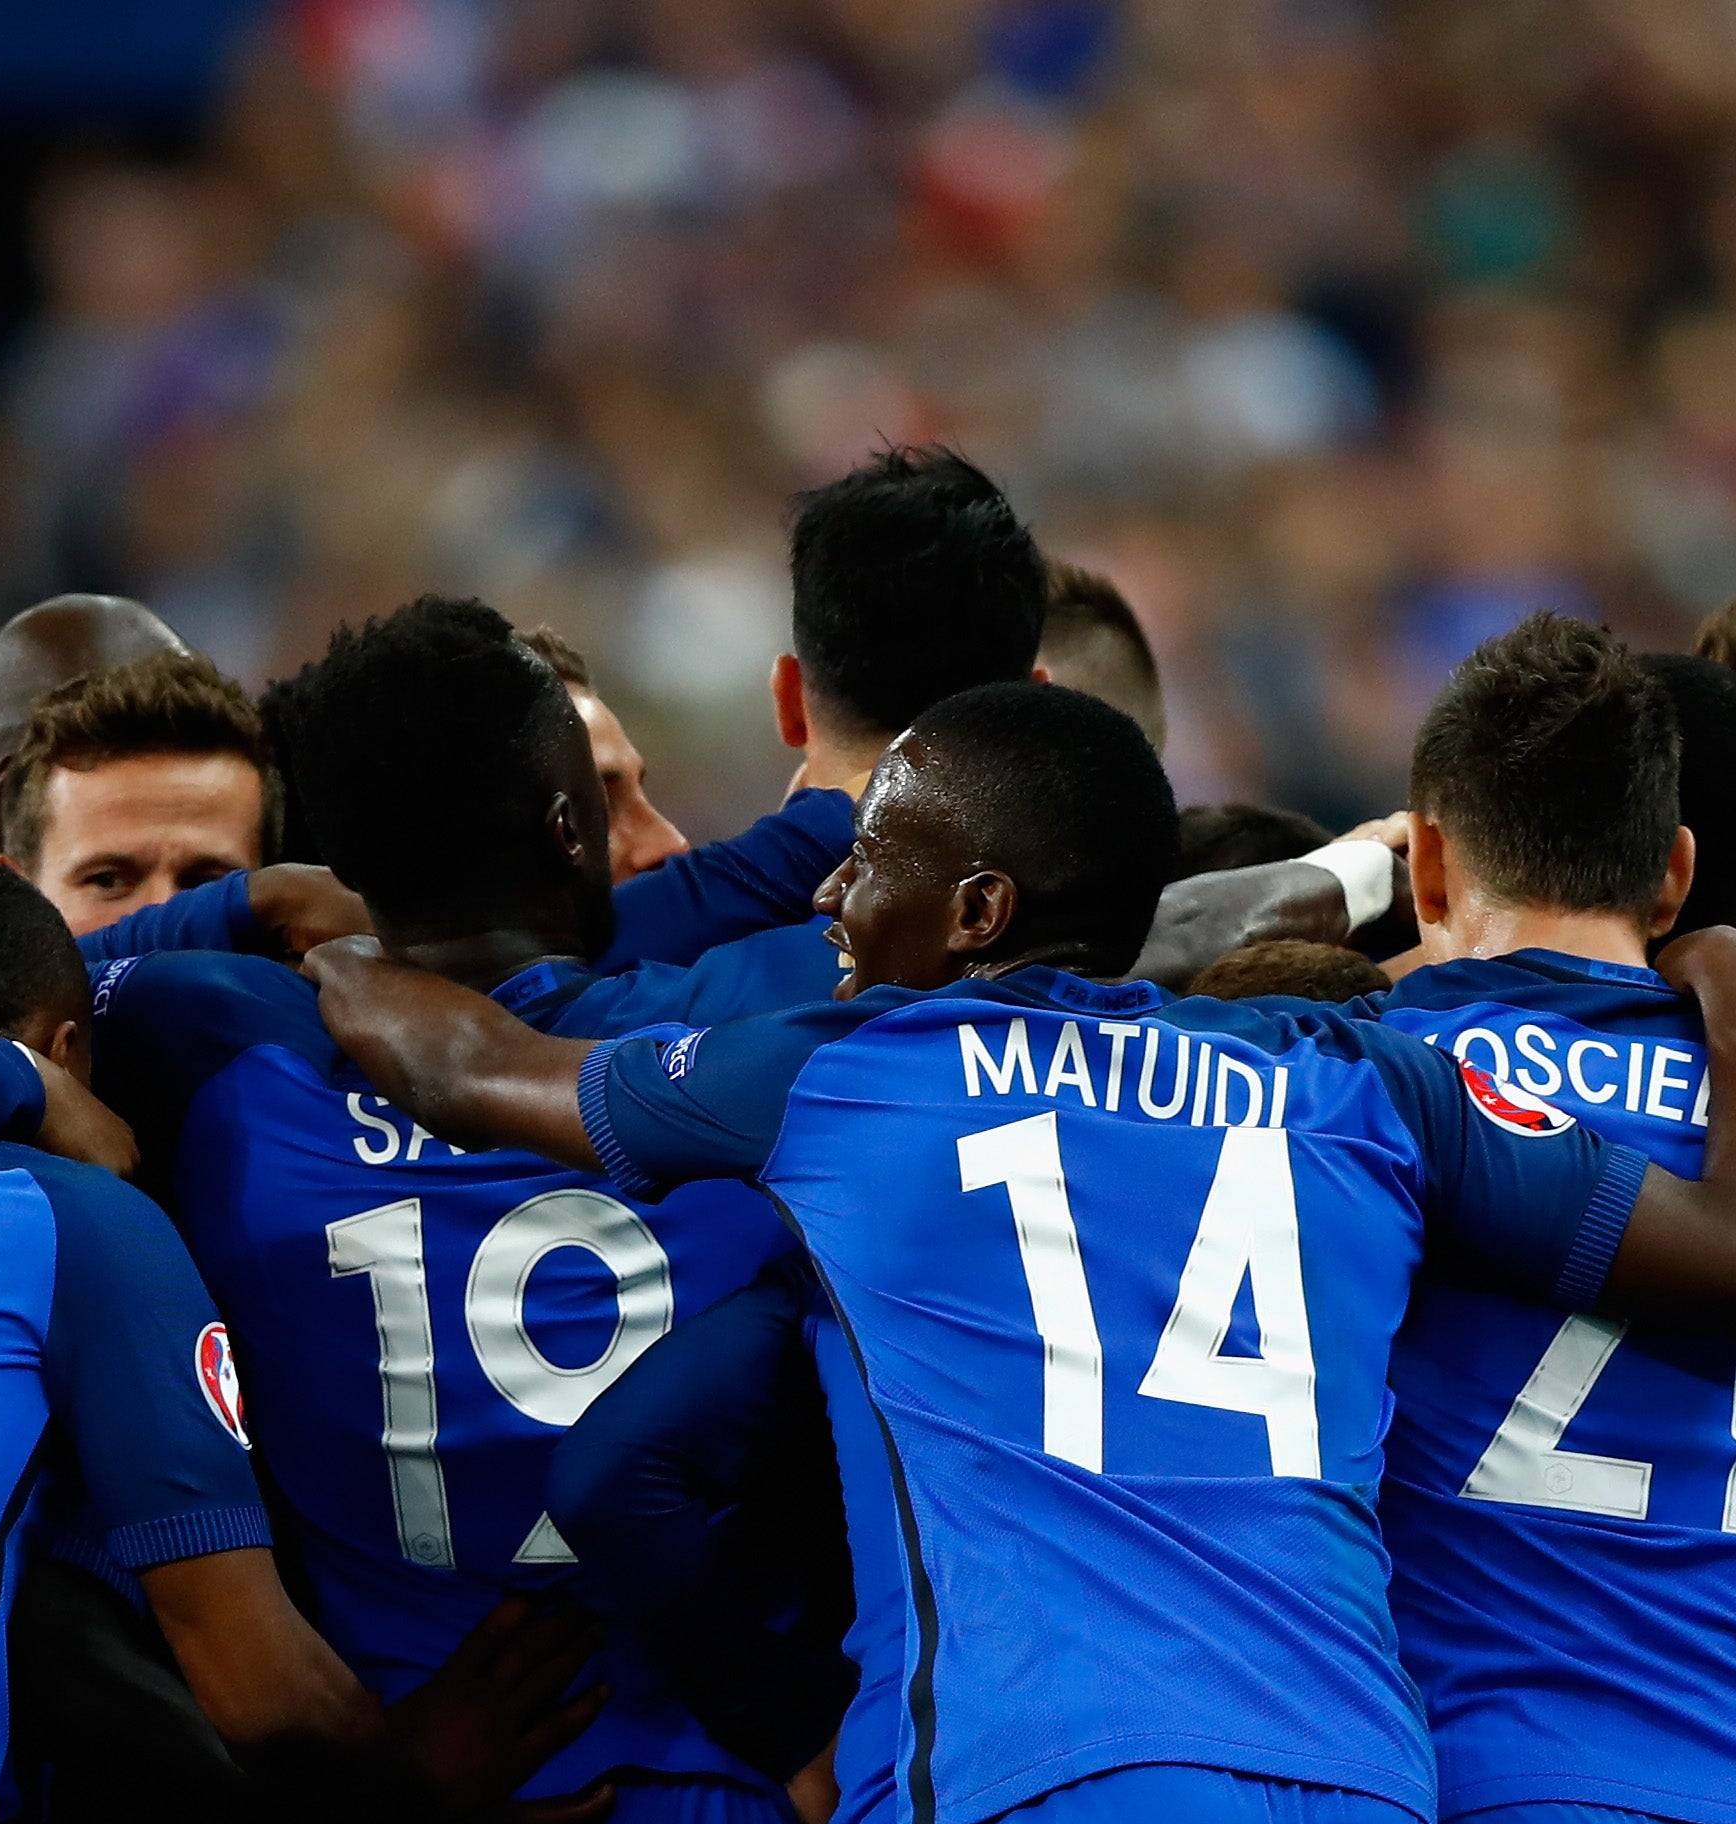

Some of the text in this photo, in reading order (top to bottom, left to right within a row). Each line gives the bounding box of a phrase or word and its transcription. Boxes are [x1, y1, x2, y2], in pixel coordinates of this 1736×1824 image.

[958, 1018, 1289, 1129] MATUIDI
[1423, 1023, 1710, 1128] OSCIE
[326, 1188, 675, 1570] 19
[956, 1111, 1321, 1480] 14
